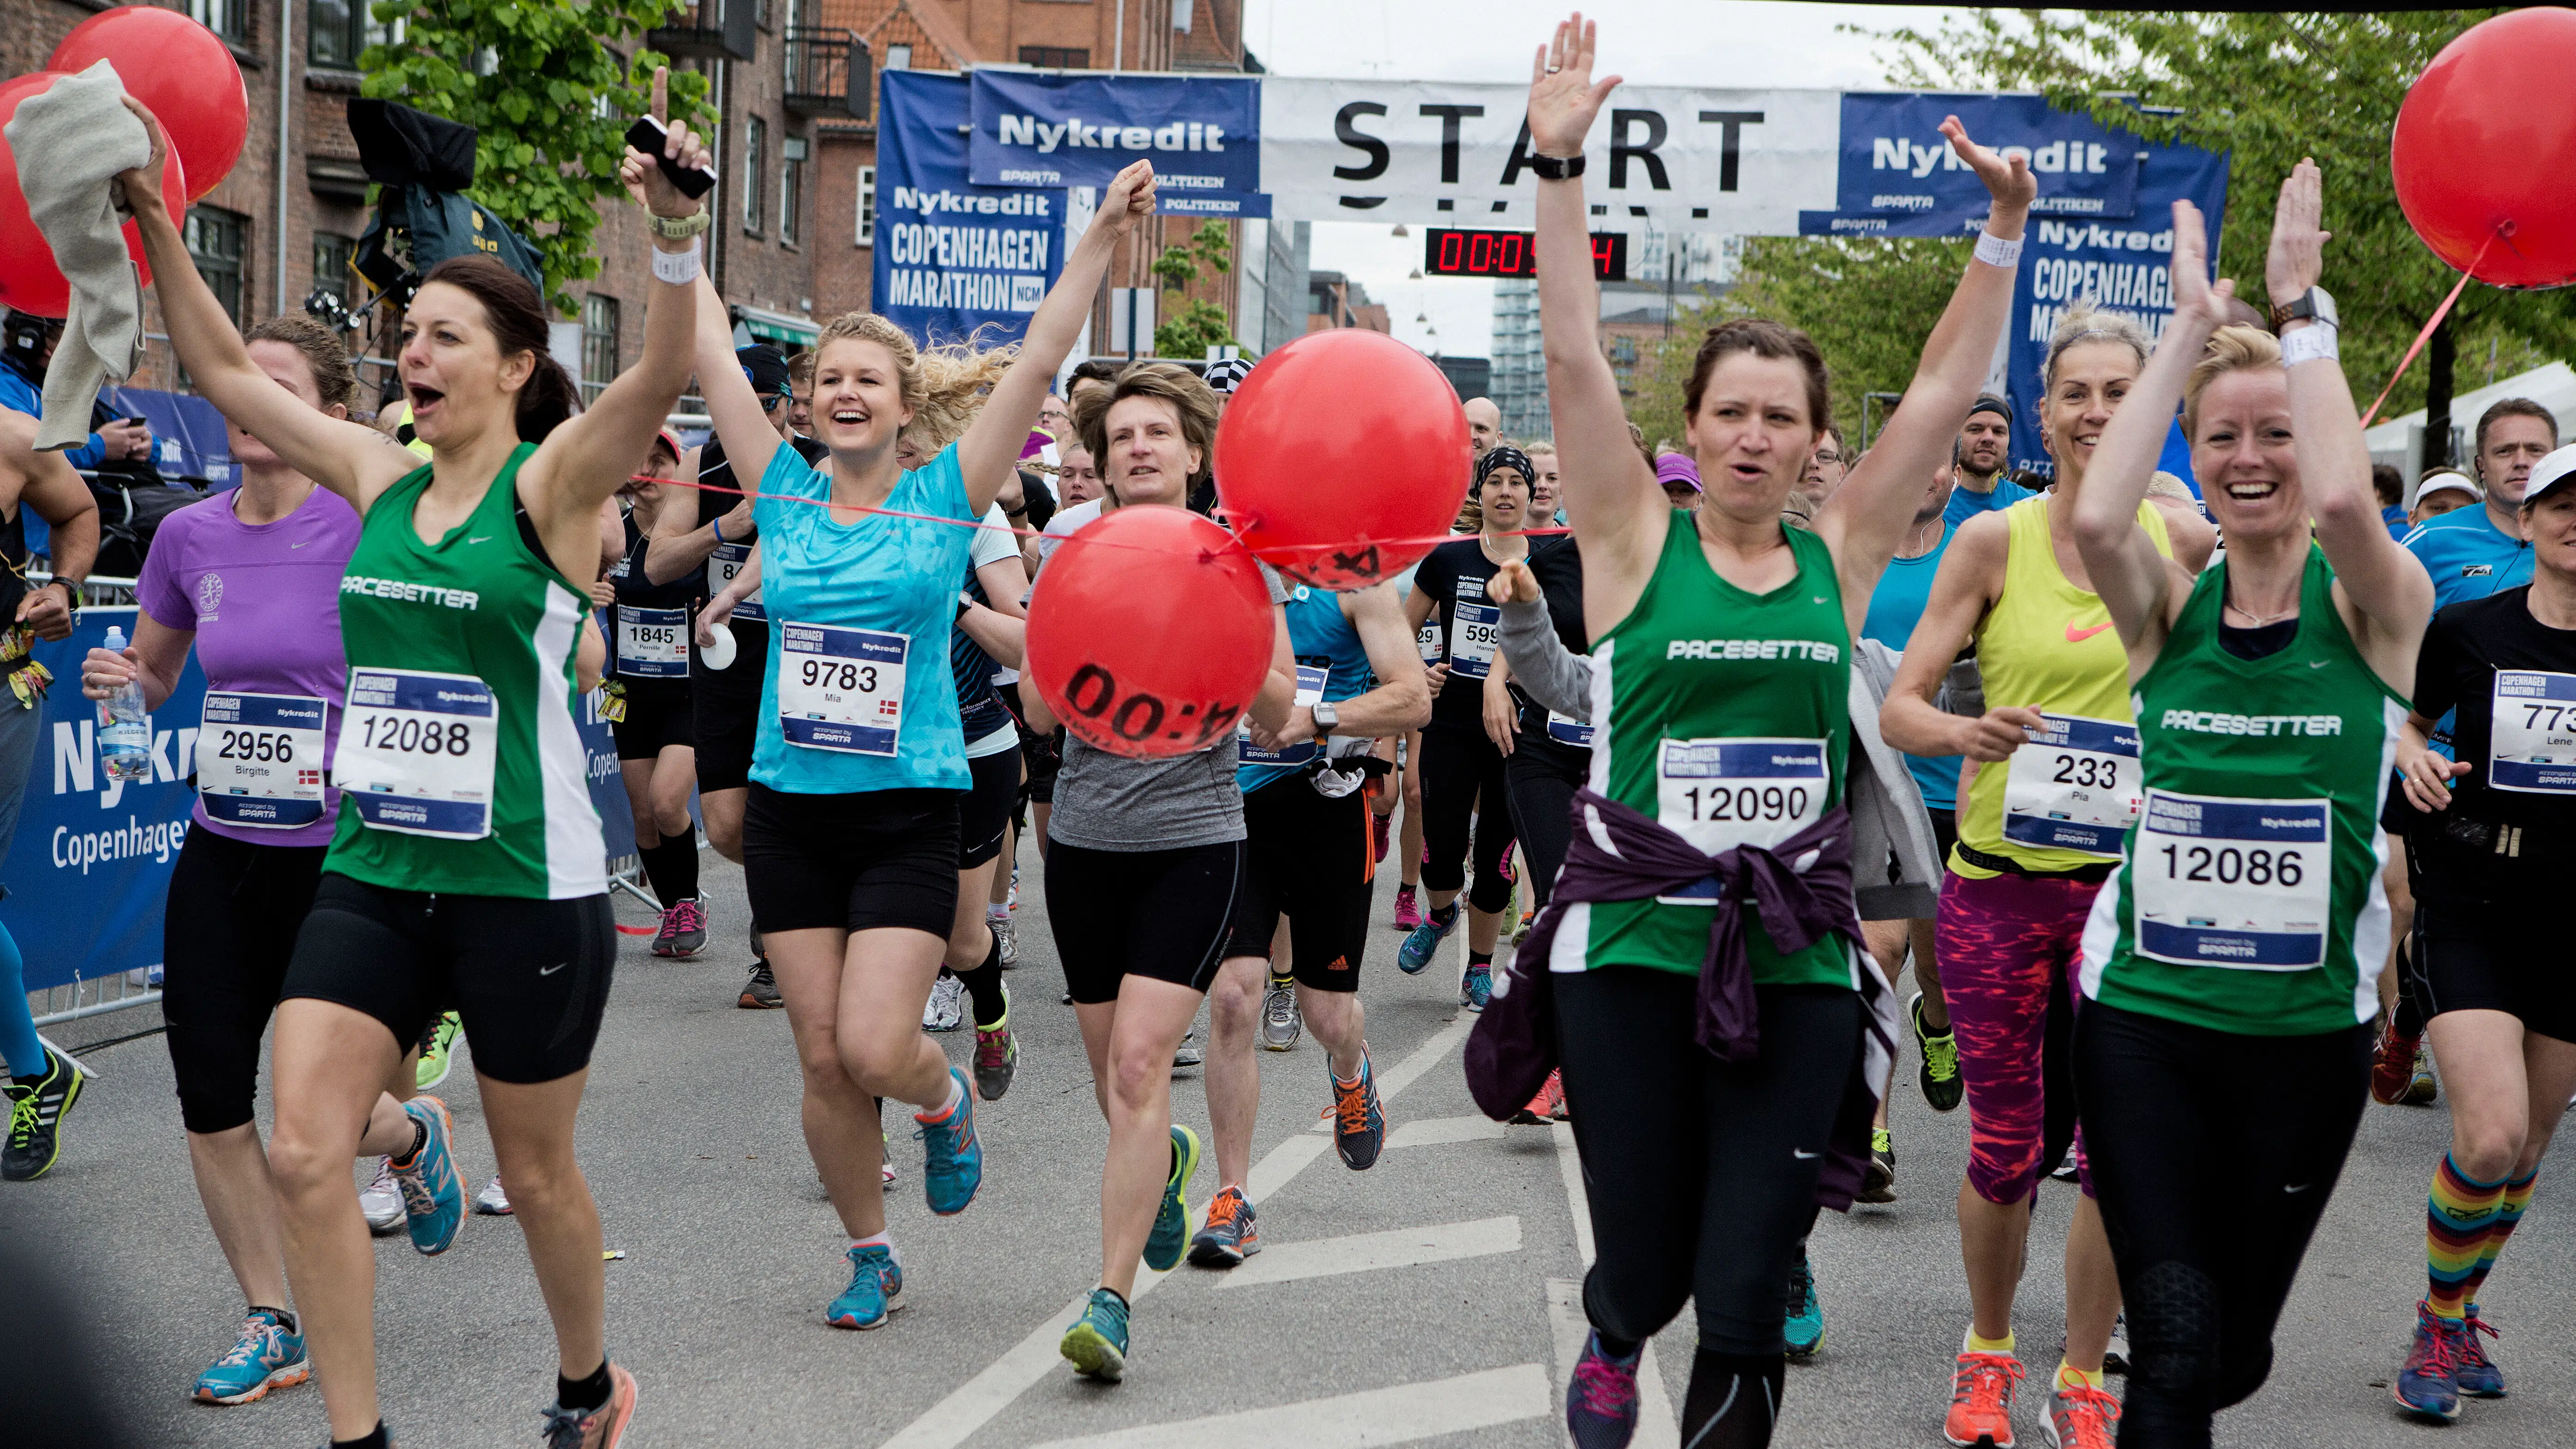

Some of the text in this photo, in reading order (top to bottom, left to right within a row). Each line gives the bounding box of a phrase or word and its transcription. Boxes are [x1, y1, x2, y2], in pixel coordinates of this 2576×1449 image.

[999, 114, 1225, 154] Nykredit
[1872, 138, 2107, 178] Nykedit
[999, 169, 1061, 183] SPARTA
[1153, 175, 1225, 188] OLITIKEN
[894, 187, 1049, 216] Nykredit
[1165, 199, 1240, 212] POLITIKEN
[1871, 195, 1934, 210] SPARTA
[2030, 198, 2104, 212] OLITIKEN
[1831, 218, 1887, 231] SPARTA
[2038, 220, 2174, 253] Nykred
[891, 223, 1048, 271] COPENHAGEN
[1438, 233, 1613, 274] 00:04
[889, 269, 1014, 311] MARATHON
[1017, 286, 1041, 302] NCM
[341, 575, 479, 611] PACESETTER
[1456, 589, 1476, 598] MARATHON
[1457, 581, 1484, 592] COPENHAGEN
[620, 608, 640, 616] COPENHAGEN
[1457, 611, 1475, 621] MARATHON
[1458, 604, 1481, 615] COPENHAGEN
[630, 627, 674, 644] 1845
[786, 628, 824, 642] COPENHAGEN
[786, 639, 814, 652] MARATHON
[862, 642, 902, 653] Nykredit
[1667, 640, 1839, 664] PACESETTER
[802, 659, 877, 693] 9783
[2501, 675, 2546, 687] COPENHAGEN
[438, 690, 489, 704] Nykredit
[825, 693, 842, 703] Mia
[2500, 686, 2535, 696] MARATHON
[207, 696, 241, 710] COPENHAGEN
[962, 705, 984, 715] recovery
[206, 708, 231, 721] MARATHON
[277, 708, 319, 718] Nykredit
[2161, 709, 2342, 737] PACESETTER
[364, 715, 470, 756] 12088
[812, 732, 852, 744] SPARTA
[2547, 737, 2573, 746] Lene
[219, 730, 293, 763] 2956
[235, 765, 270, 777] Birgitte
[2053, 755, 2117, 790] 233
[2072, 791, 2089, 802] Pia
[1685, 787, 1807, 821] 12090
[238, 809, 277, 819] SPARTA
[379, 809, 427, 823] SPARTA
[2261, 817, 2321, 829] Nykredit
[52, 814, 191, 875] Copenhage
[2053, 833, 2098, 846] SPARTA
[2162, 844, 2302, 887] 12086
[2197, 943, 2257, 958] SPARTA
